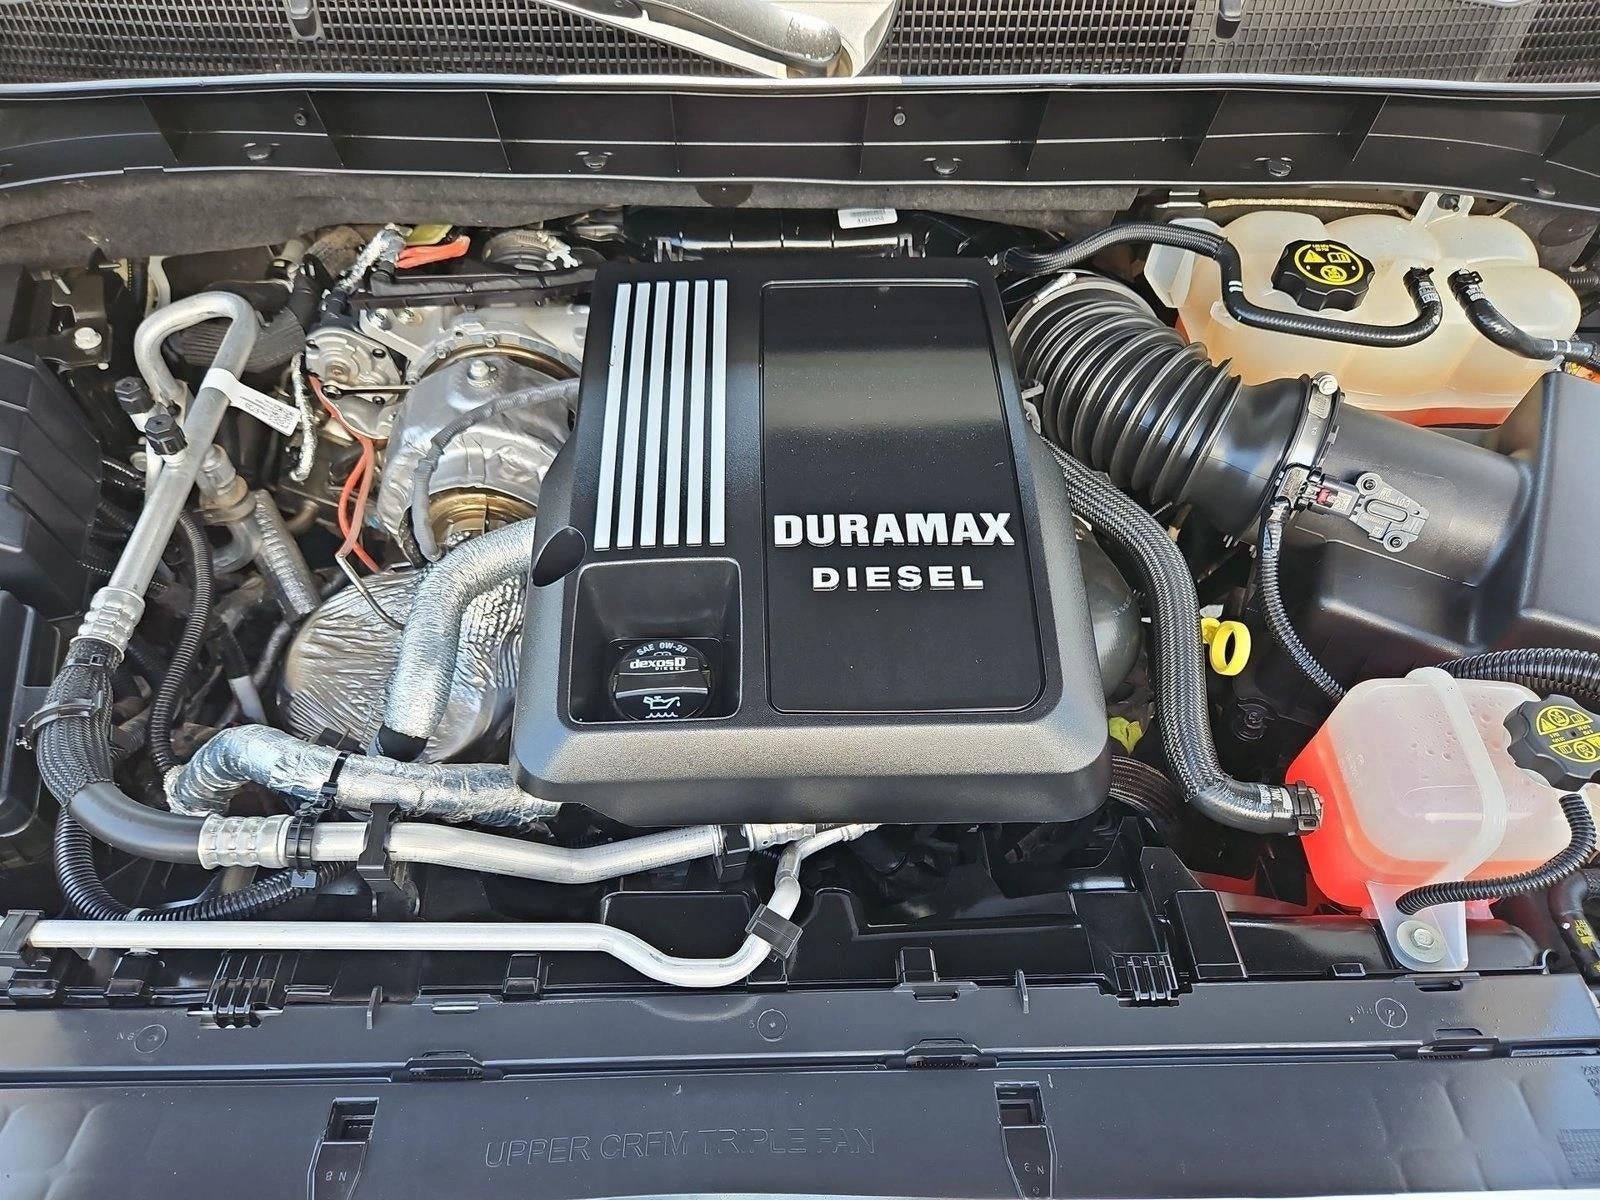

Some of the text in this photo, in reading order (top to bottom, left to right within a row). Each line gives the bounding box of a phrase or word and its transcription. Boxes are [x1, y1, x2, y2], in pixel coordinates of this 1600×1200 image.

[774, 512, 1015, 548] DURAMAX
[812, 565, 984, 592] DIESEL
[636, 643, 655, 656] SAE
[485, 1135, 591, 1168] UPPER
[600, 1130, 689, 1160] CRFM
[698, 1128, 807, 1154] TRPLE
